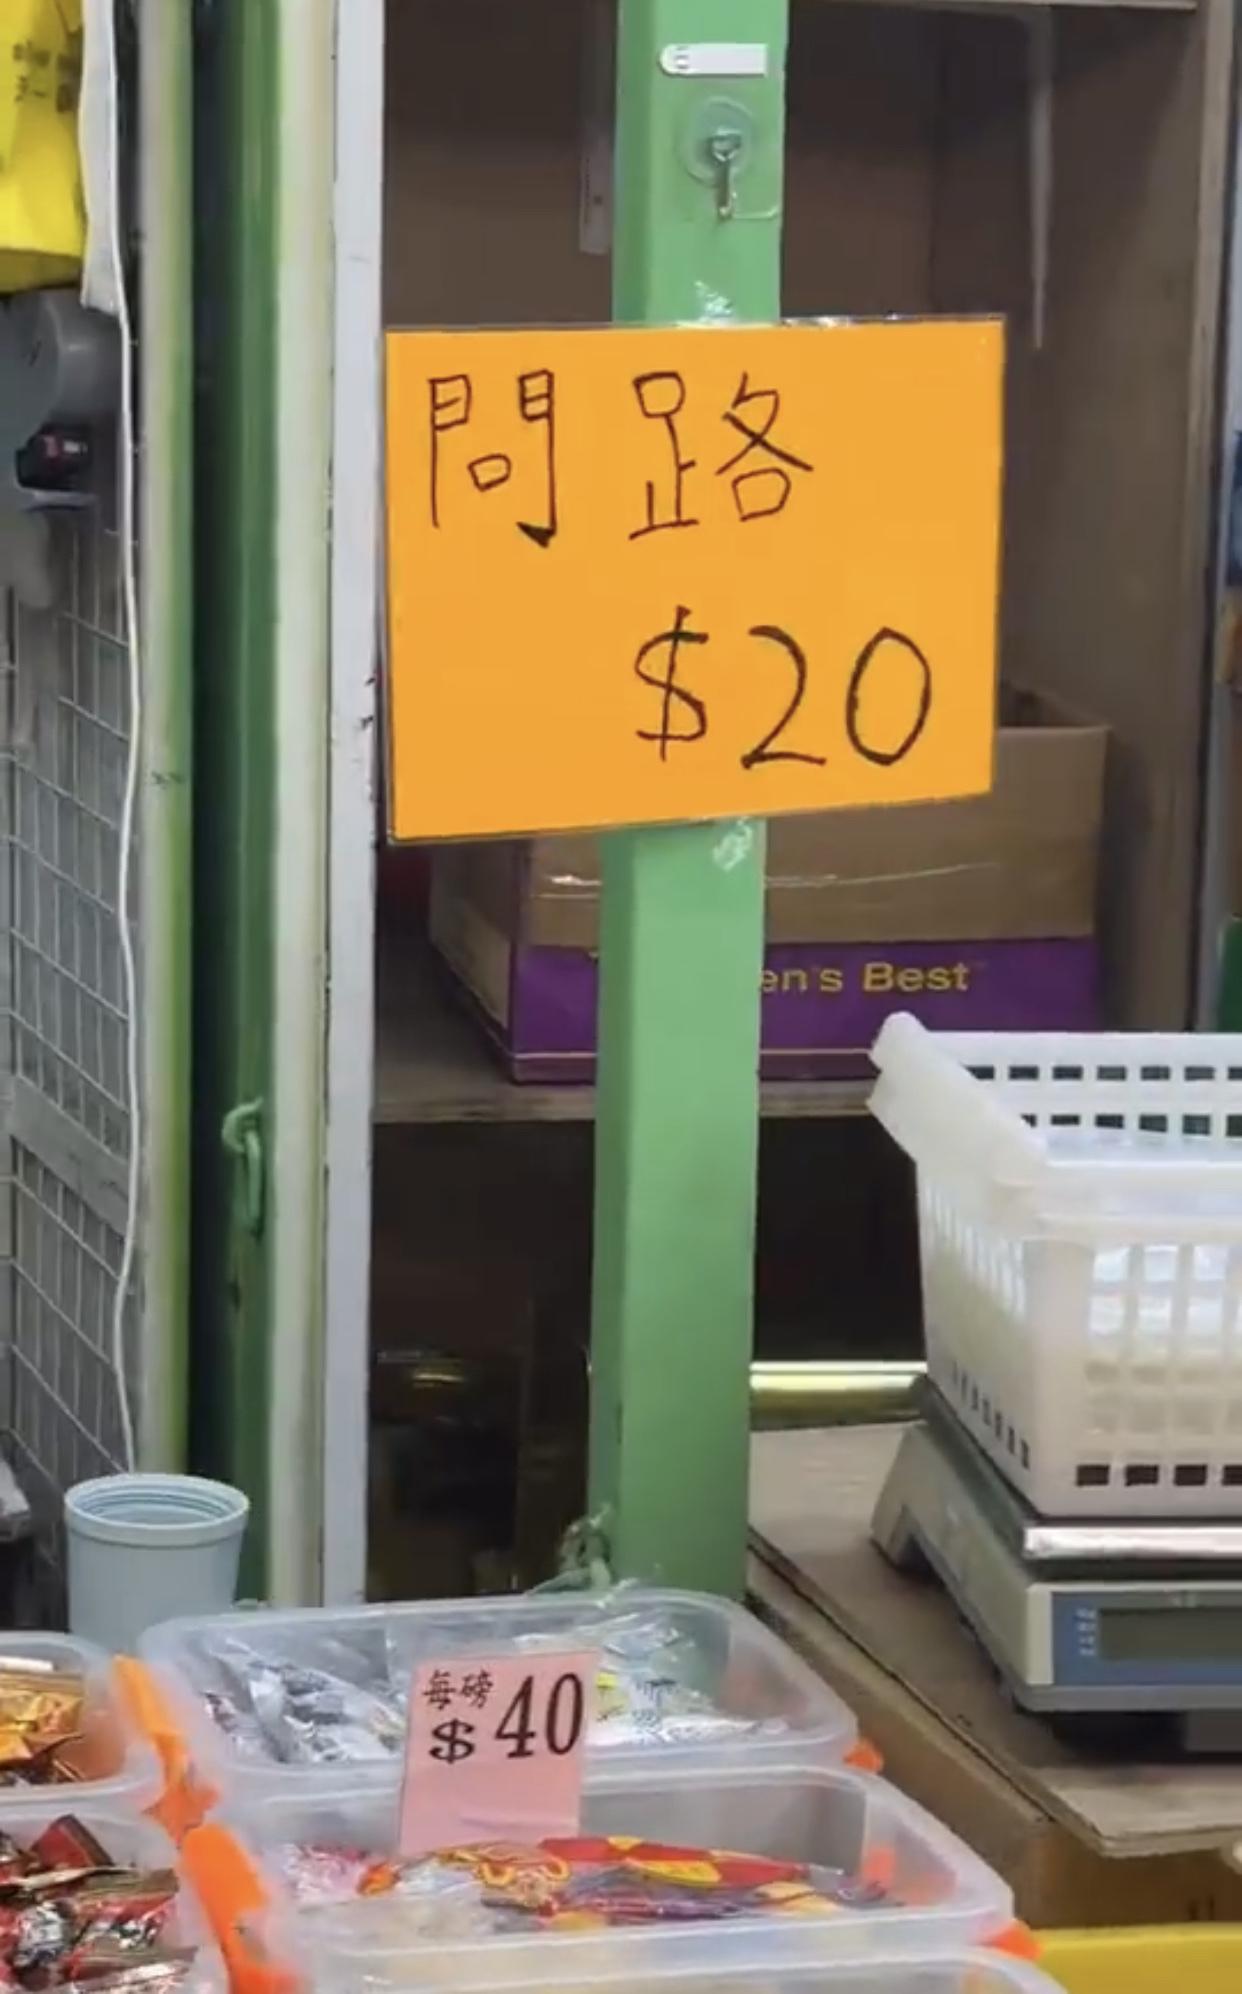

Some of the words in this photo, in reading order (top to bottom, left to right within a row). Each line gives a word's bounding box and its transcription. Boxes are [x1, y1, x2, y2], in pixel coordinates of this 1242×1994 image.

[427, 368, 815, 548] 問路
[633, 604, 933, 771] $20
[863, 961, 969, 992] Best
[422, 1669, 494, 1711] 每磅
